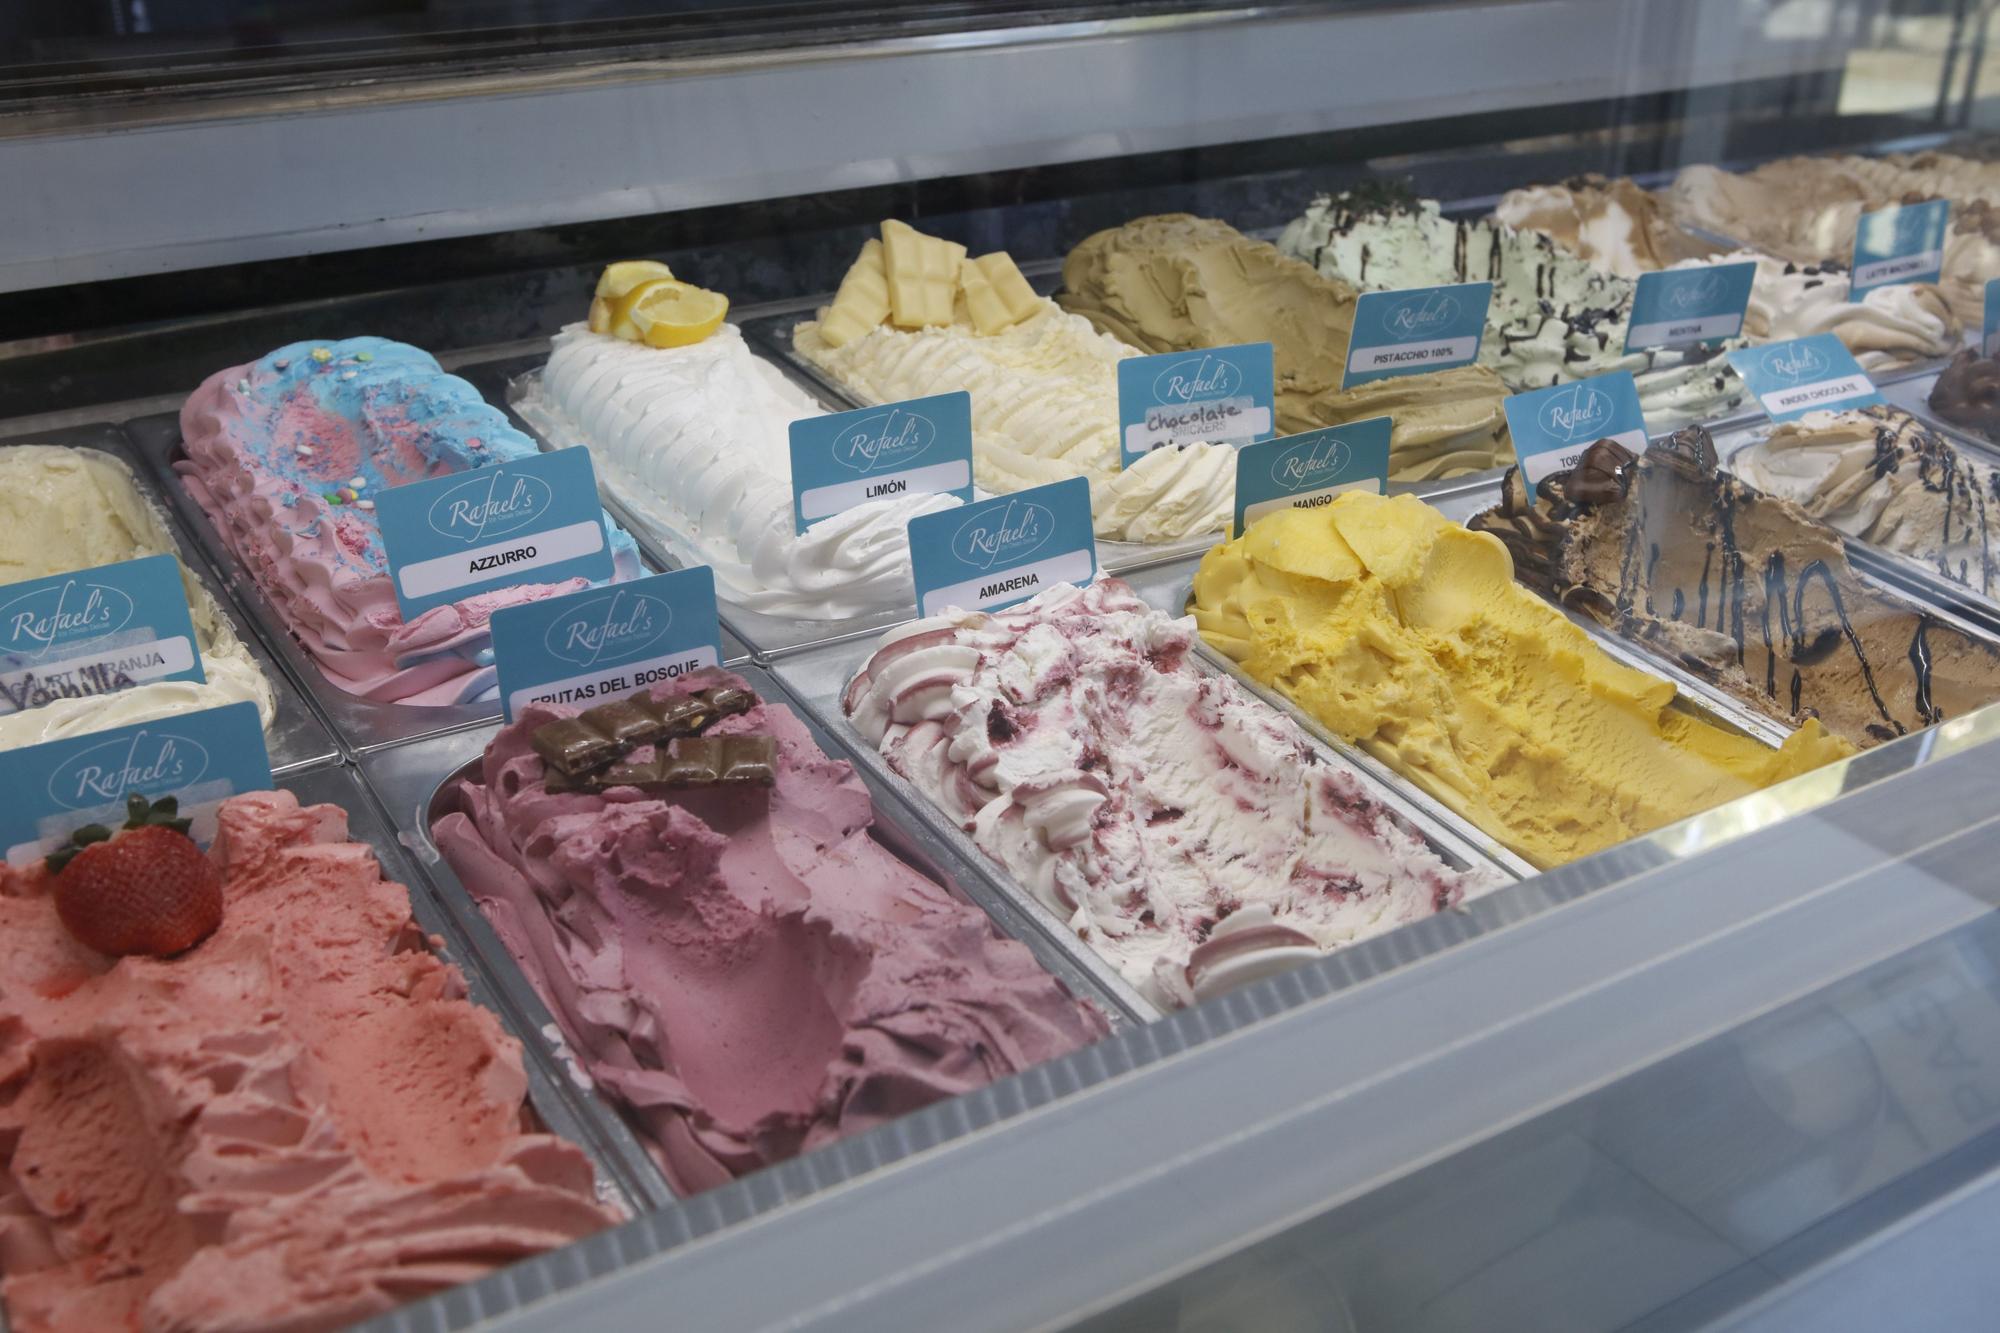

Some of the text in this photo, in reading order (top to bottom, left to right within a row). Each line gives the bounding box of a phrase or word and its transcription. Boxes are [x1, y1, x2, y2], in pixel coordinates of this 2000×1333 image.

[1393, 290, 1448, 338] Rafael's
[1374, 347, 1453, 365] PISTACCHIO 100%
[1168, 354, 1228, 408] Rafael's
[1809, 382, 1859, 400] CHOCOLATE
[1147, 403, 1242, 432] Chocolate
[1551, 385, 1603, 441] Rafael's
[850, 408, 920, 472] Rafael's
[1283, 435, 1339, 490] Rafael's
[1560, 454, 1581, 468] TOB
[449, 470, 533, 543] Rafael's
[866, 480, 906, 498] LIMÓN
[1293, 494, 1332, 509] MANGO
[969, 499, 1038, 569] Rafael's
[469, 546, 537, 574] AZZURRO
[979, 573, 1039, 599] AMARENA
[10, 580, 111, 659] Rafael's
[566, 590, 652, 667] Rafael's
[599, 678, 631, 695] DEL
[76, 730, 184, 816] Rafael's
